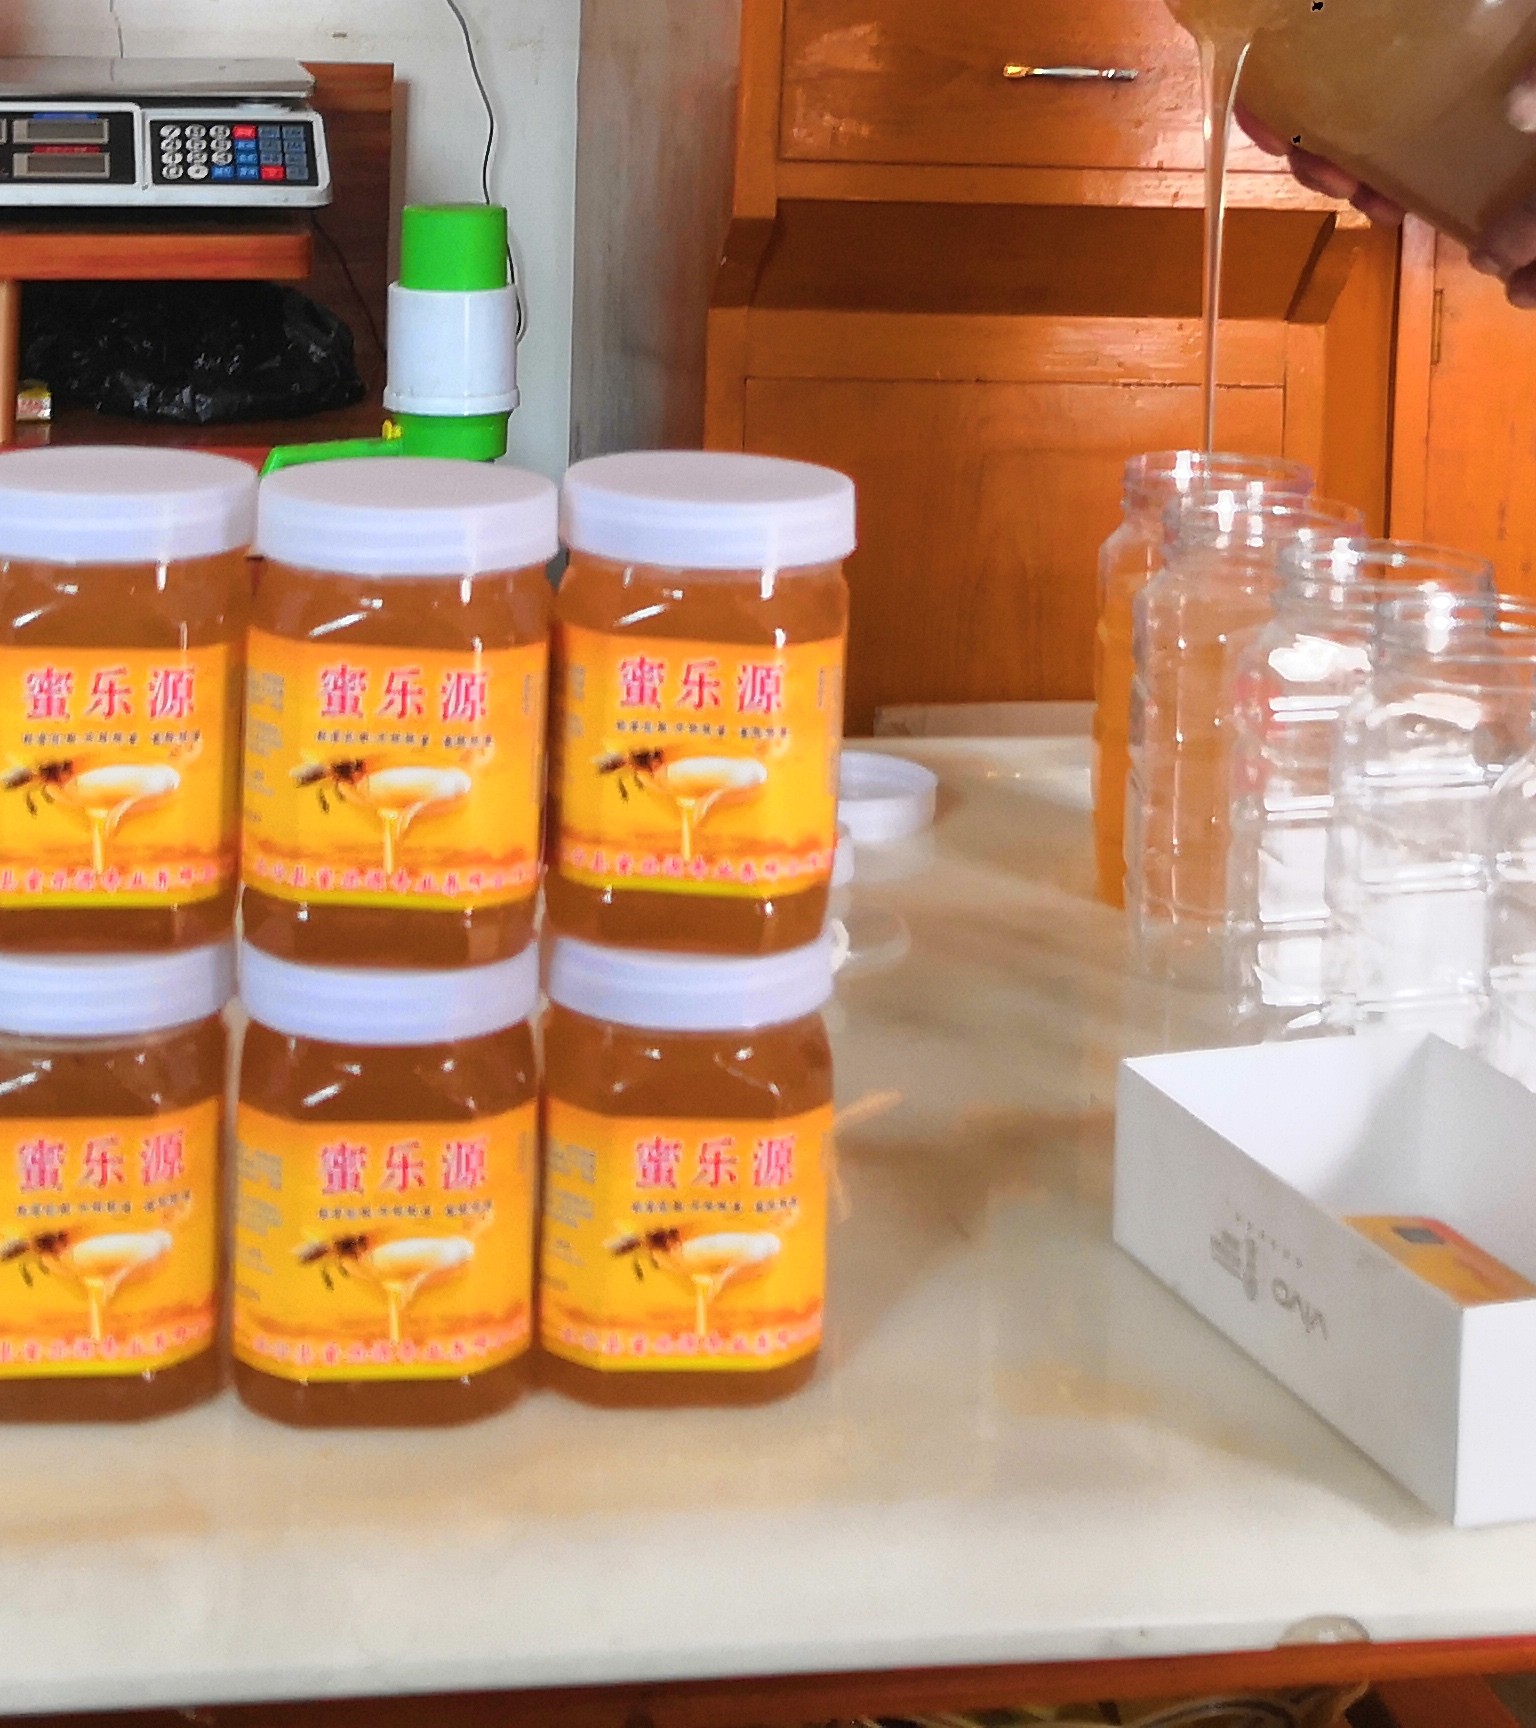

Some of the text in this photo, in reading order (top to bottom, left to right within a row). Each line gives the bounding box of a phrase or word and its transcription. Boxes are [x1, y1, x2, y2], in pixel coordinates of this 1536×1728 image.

[26, 666, 196, 720] 蜜乐源
[319, 663, 488, 722] 蜜乐源
[619, 656, 787, 715] 蜜乐源
[17, 1129, 187, 1193] 蜜乐源
[319, 1136, 490, 1194] 蜜乐源
[635, 1134, 797, 1189] 蜜乐源
